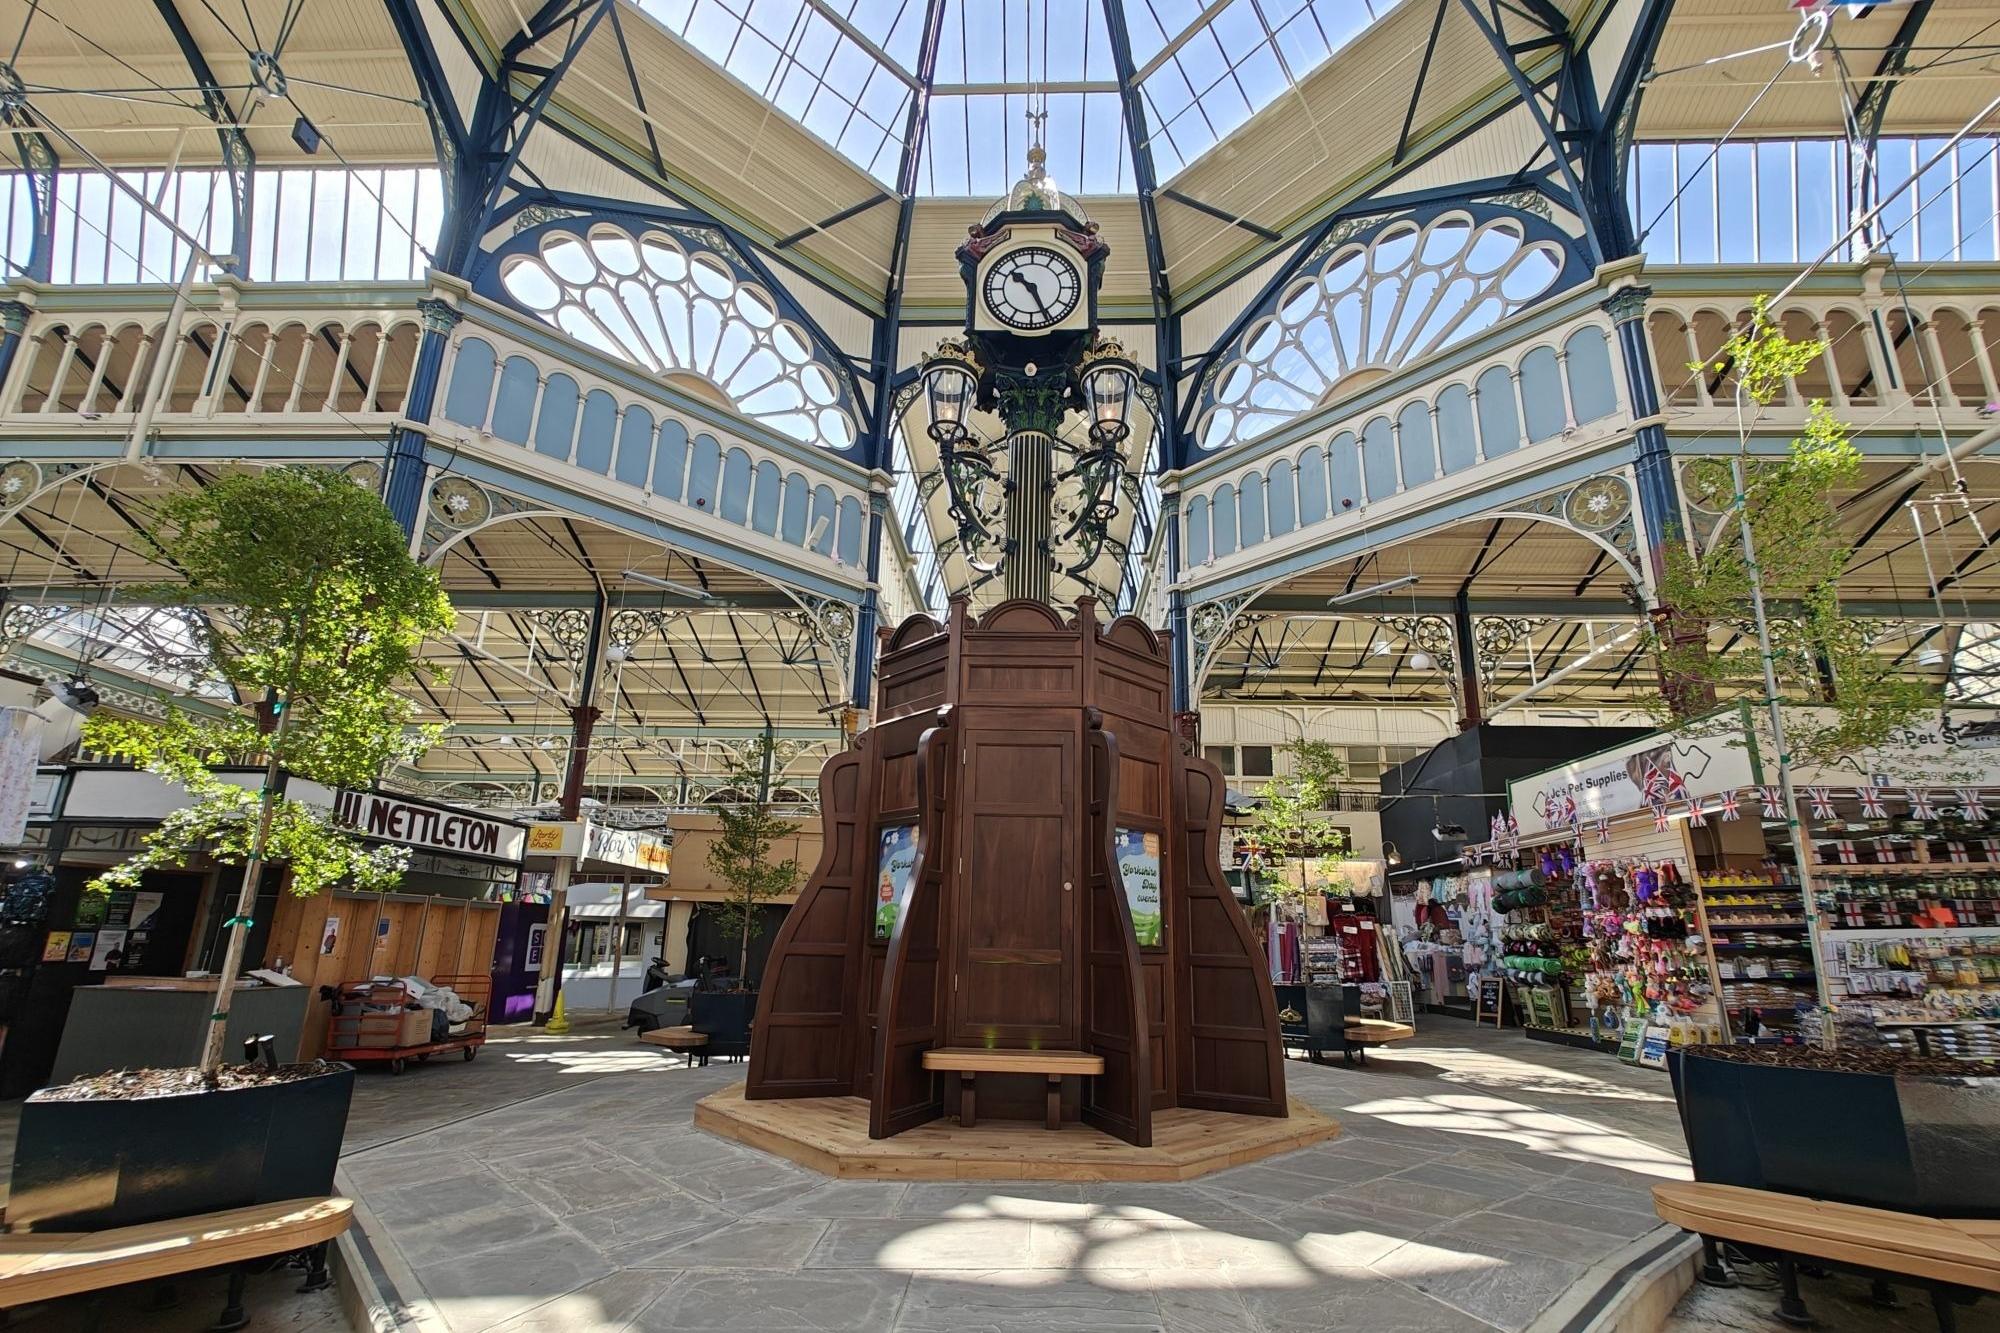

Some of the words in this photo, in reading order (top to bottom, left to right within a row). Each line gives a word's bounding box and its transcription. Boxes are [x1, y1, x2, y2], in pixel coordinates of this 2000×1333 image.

[1903, 730, 1938, 745] Pet
[1550, 786, 1567, 799] Jc's
[1567, 782, 1584, 797] Pet
[1585, 770, 1628, 789] Supplies
[368, 798, 500, 854] NETTLETON
[530, 838, 553, 850] Shop
[594, 831, 637, 859] Roy's
[1123, 863, 1157, 877] Yorkshire
[1142, 879, 1157, 893] Day
[1137, 894, 1158, 903] events
